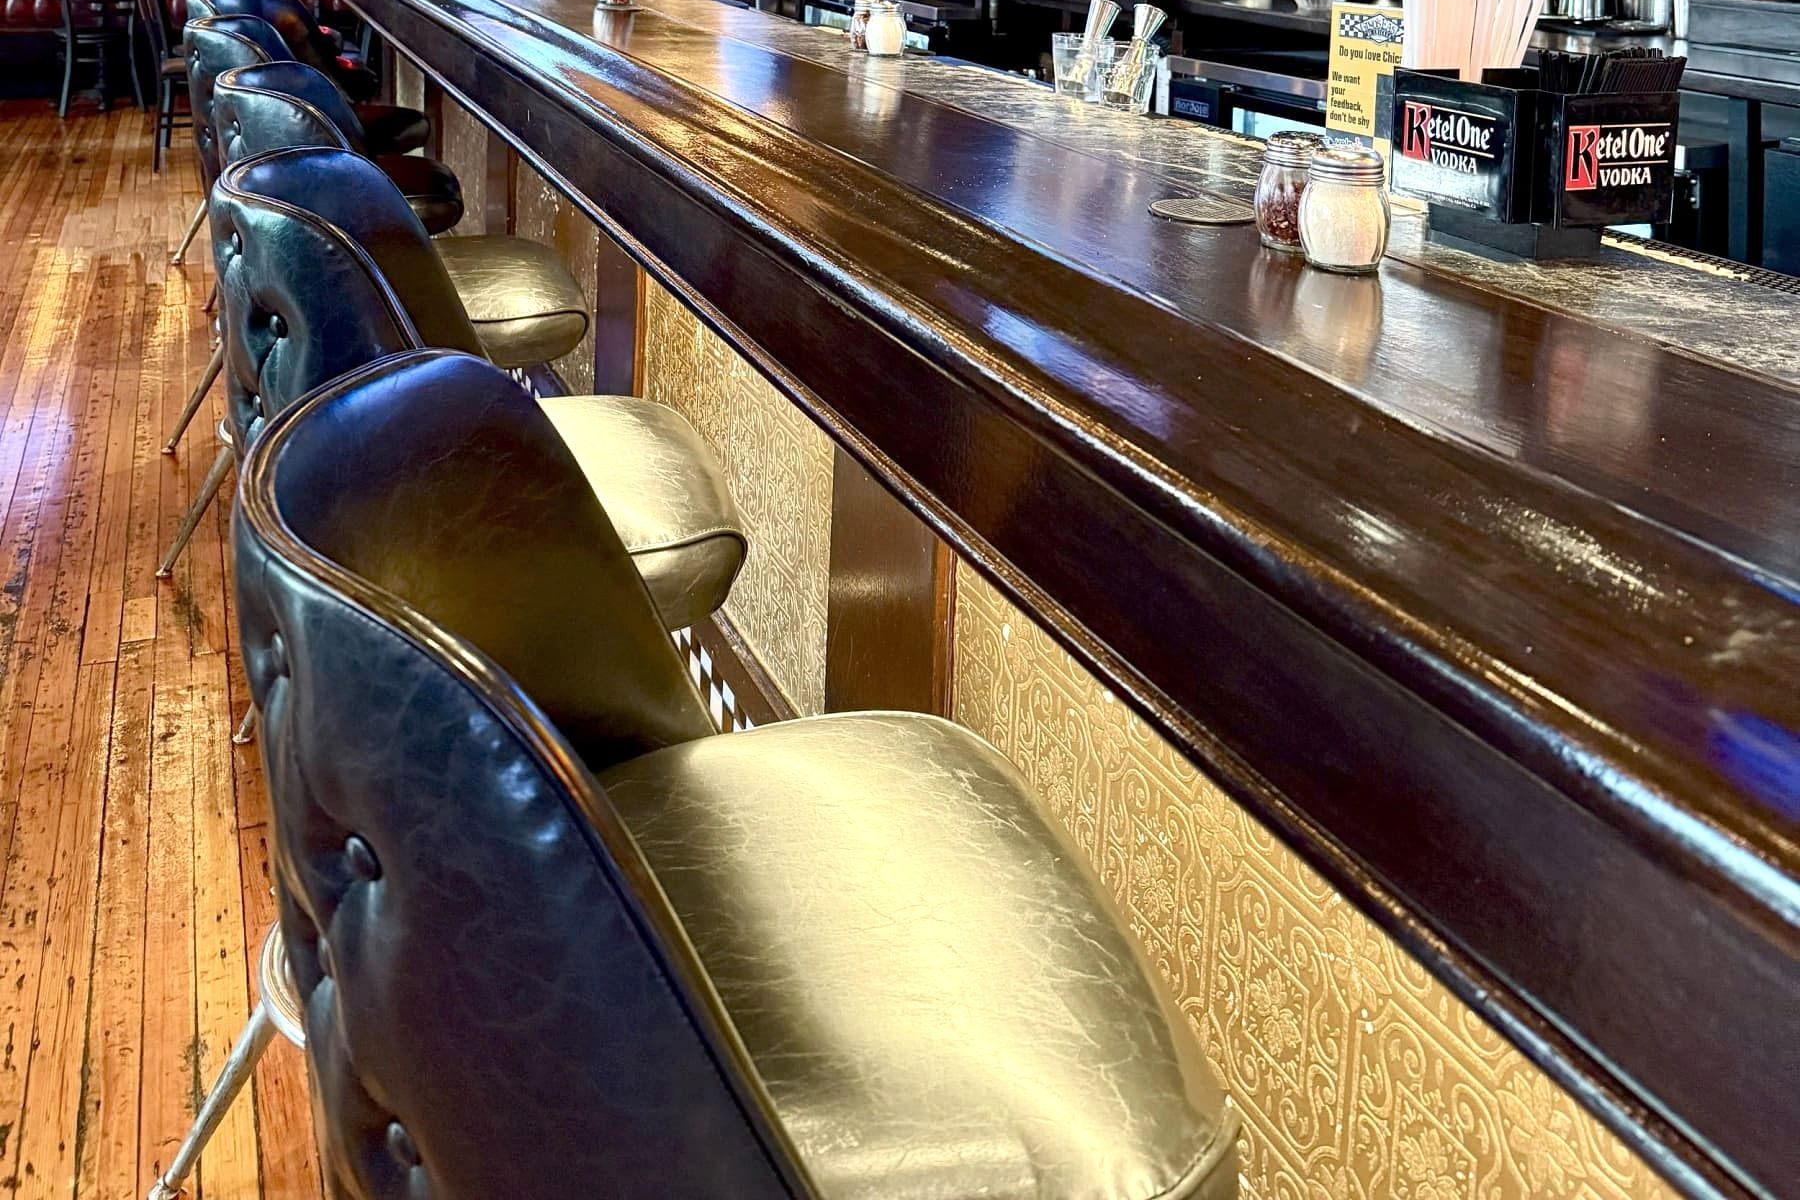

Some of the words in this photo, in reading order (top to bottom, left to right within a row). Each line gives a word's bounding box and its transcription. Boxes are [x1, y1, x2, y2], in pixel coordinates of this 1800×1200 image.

[1339, 45, 1349, 57] Do
[1350, 48, 1364, 60] you
[1365, 49, 1381, 61] love
[1332, 71, 1343, 82] We
[1343, 74, 1361, 85] want
[1331, 86, 1346, 96] your
[1330, 98, 1363, 113] feedback,
[1330, 110, 1347, 123] don't
[1348, 114, 1356, 125] be
[1357, 115, 1370, 129] shy
[1406, 106, 1455, 160] Ketel
[1456, 116, 1490, 150] One
[1431, 148, 1478, 175] VODKA
[1569, 128, 1627, 185] Ketel
[1629, 127, 1665, 158] One
[1599, 167, 1652, 187] VODKA
